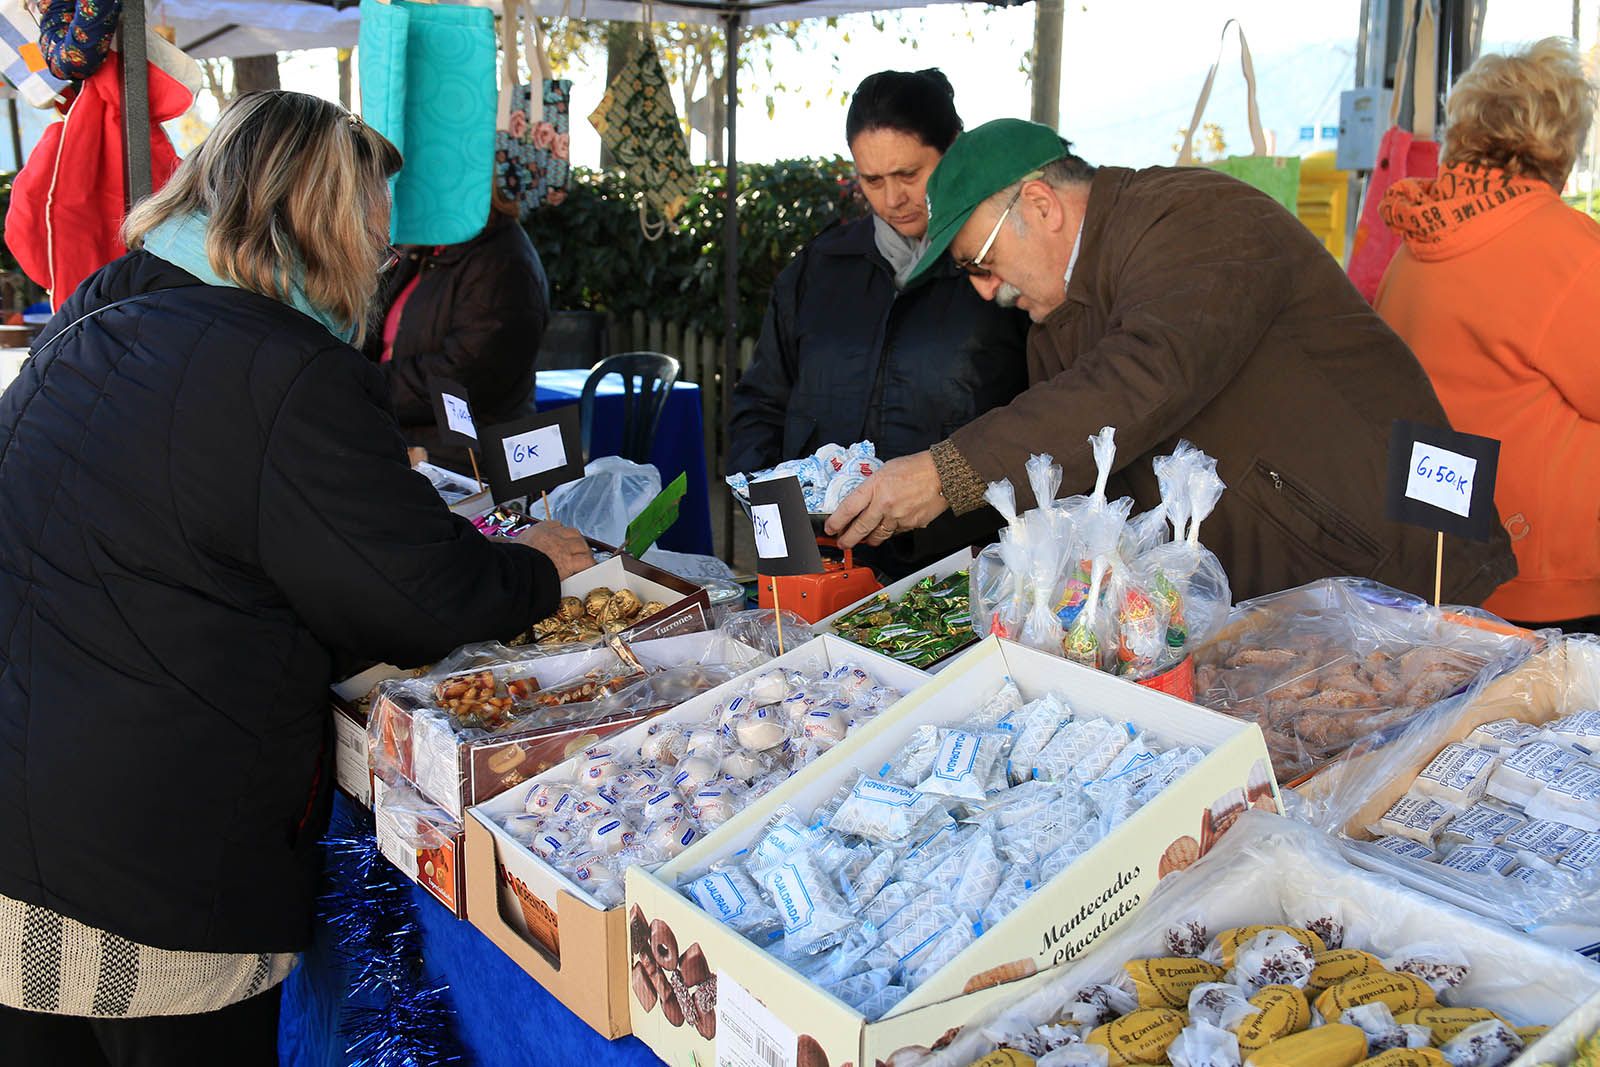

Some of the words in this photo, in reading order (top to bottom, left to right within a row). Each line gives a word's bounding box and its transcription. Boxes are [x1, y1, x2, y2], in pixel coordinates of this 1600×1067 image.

[654, 612, 694, 637] Turrones
[945, 733, 966, 774] HOJALDRADA
[703, 877, 733, 917] HOJALDRADA
[774, 871, 801, 925] HOJALDRADA
[1039, 865, 1141, 956] Mantecados
[1052, 893, 1141, 966] Chocolates
